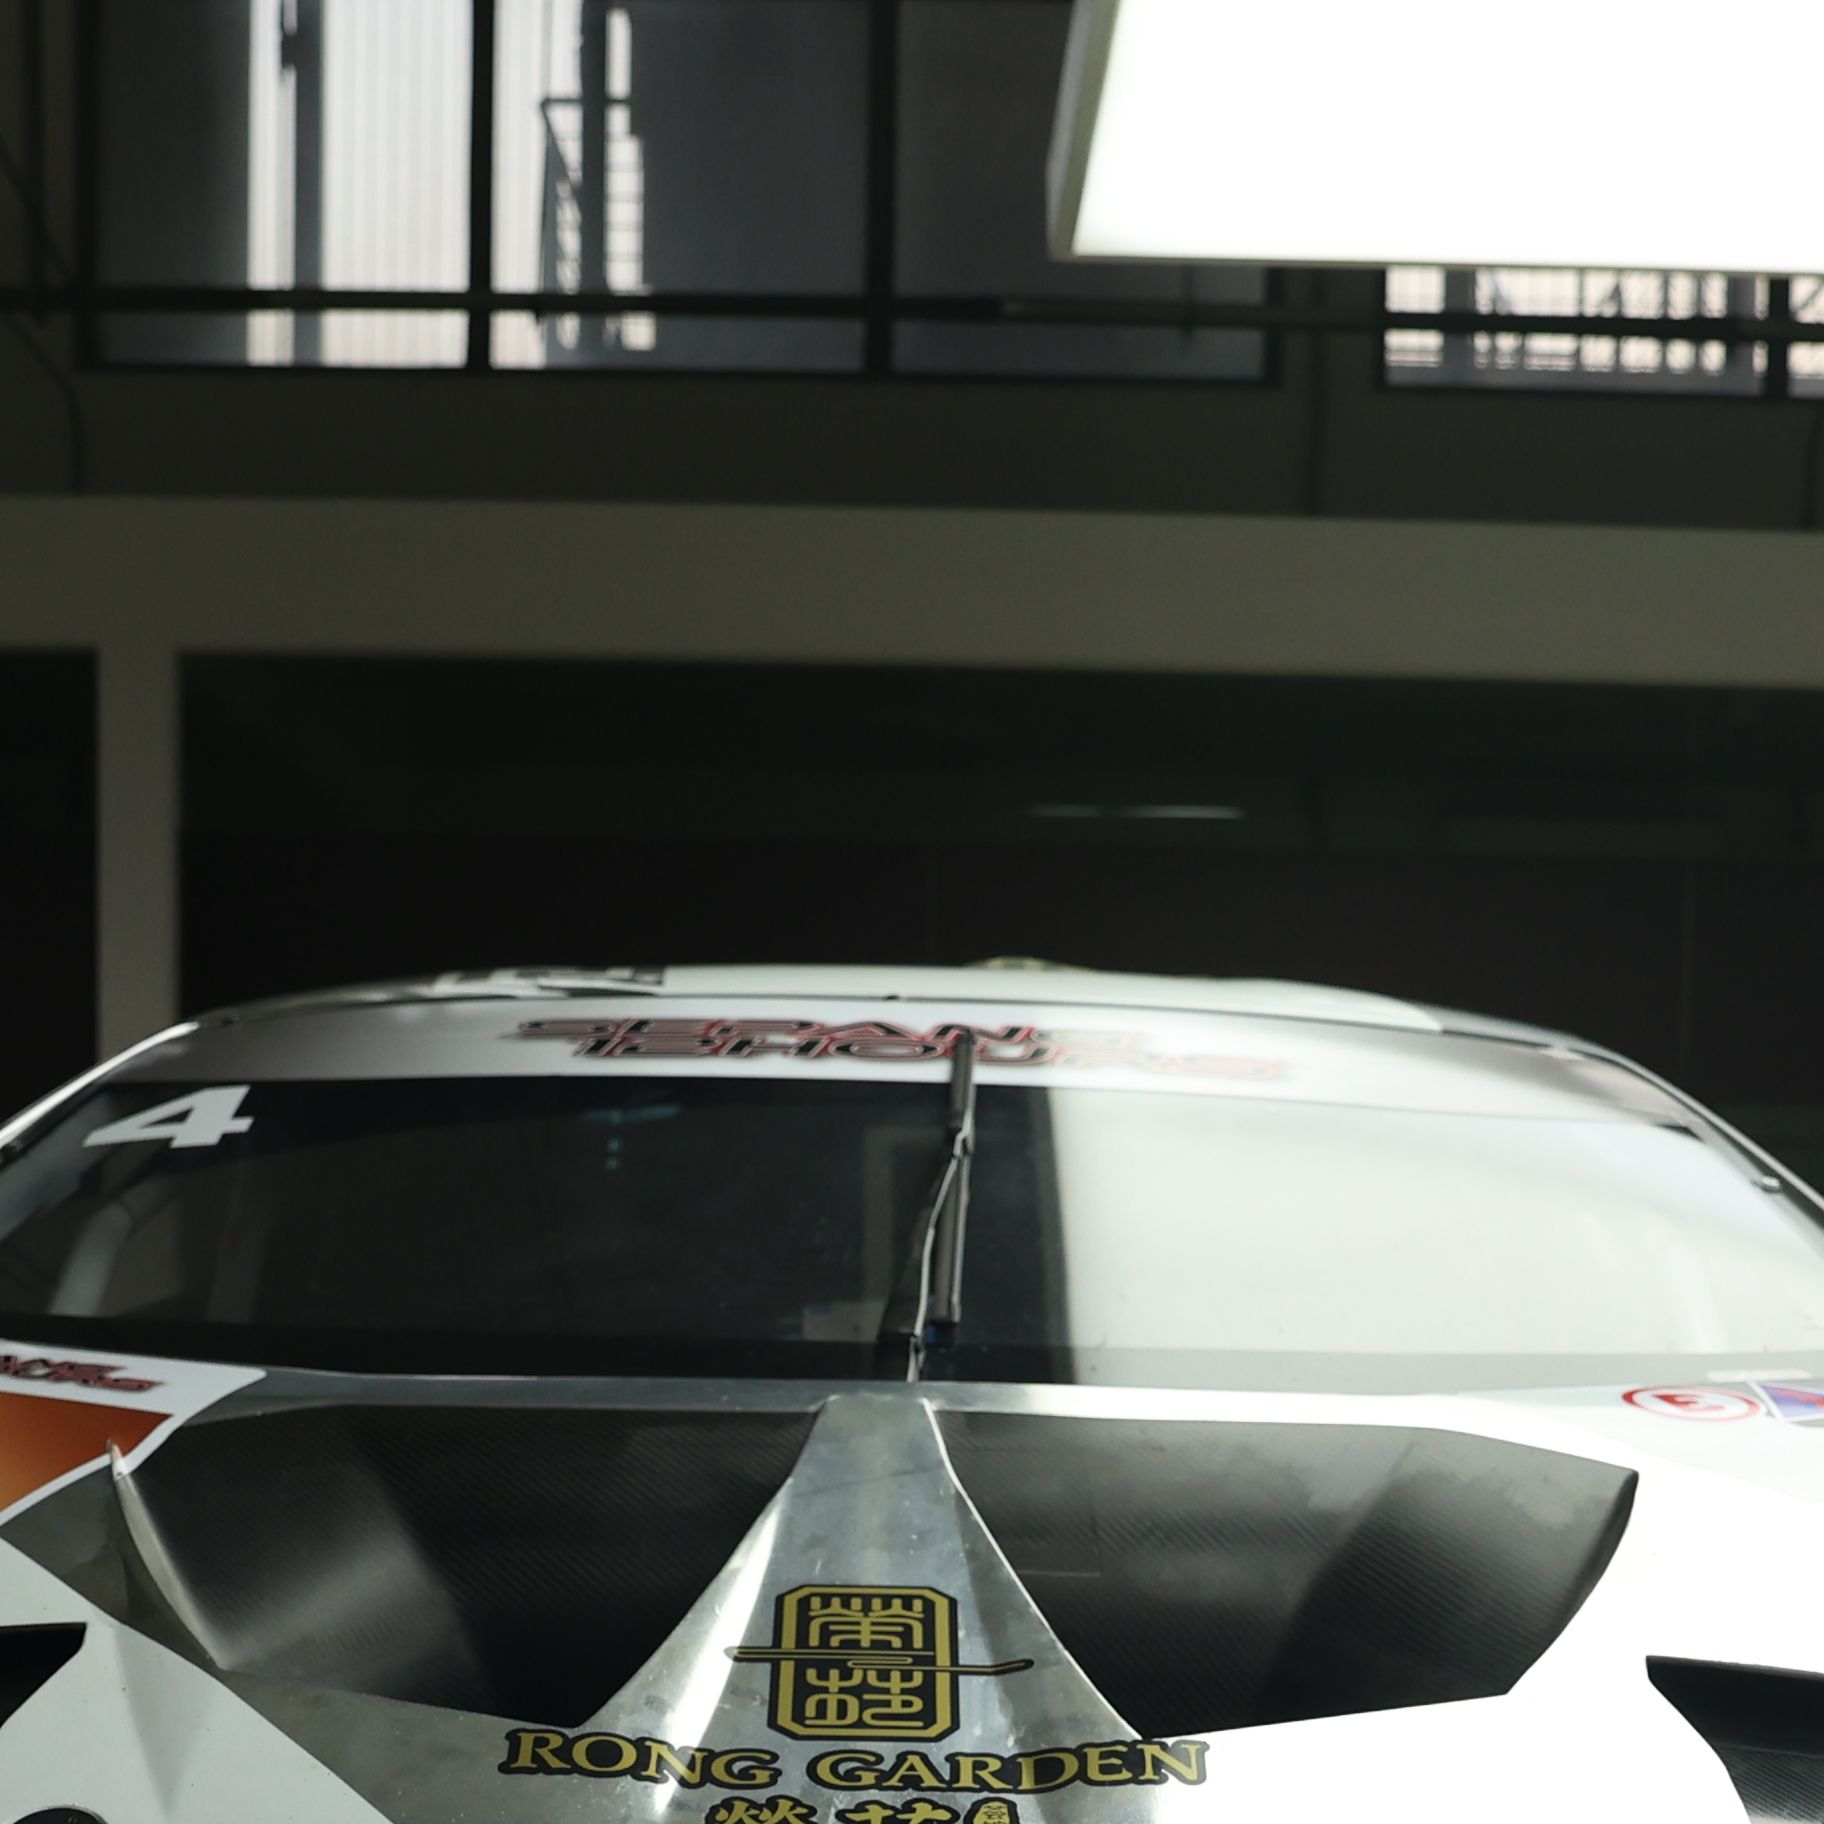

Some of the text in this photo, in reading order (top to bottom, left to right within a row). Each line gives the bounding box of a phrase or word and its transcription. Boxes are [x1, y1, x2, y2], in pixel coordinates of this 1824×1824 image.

[84, 1084, 254, 1147] 4
[510, 1731, 1208, 1794] RONG GARDEN
